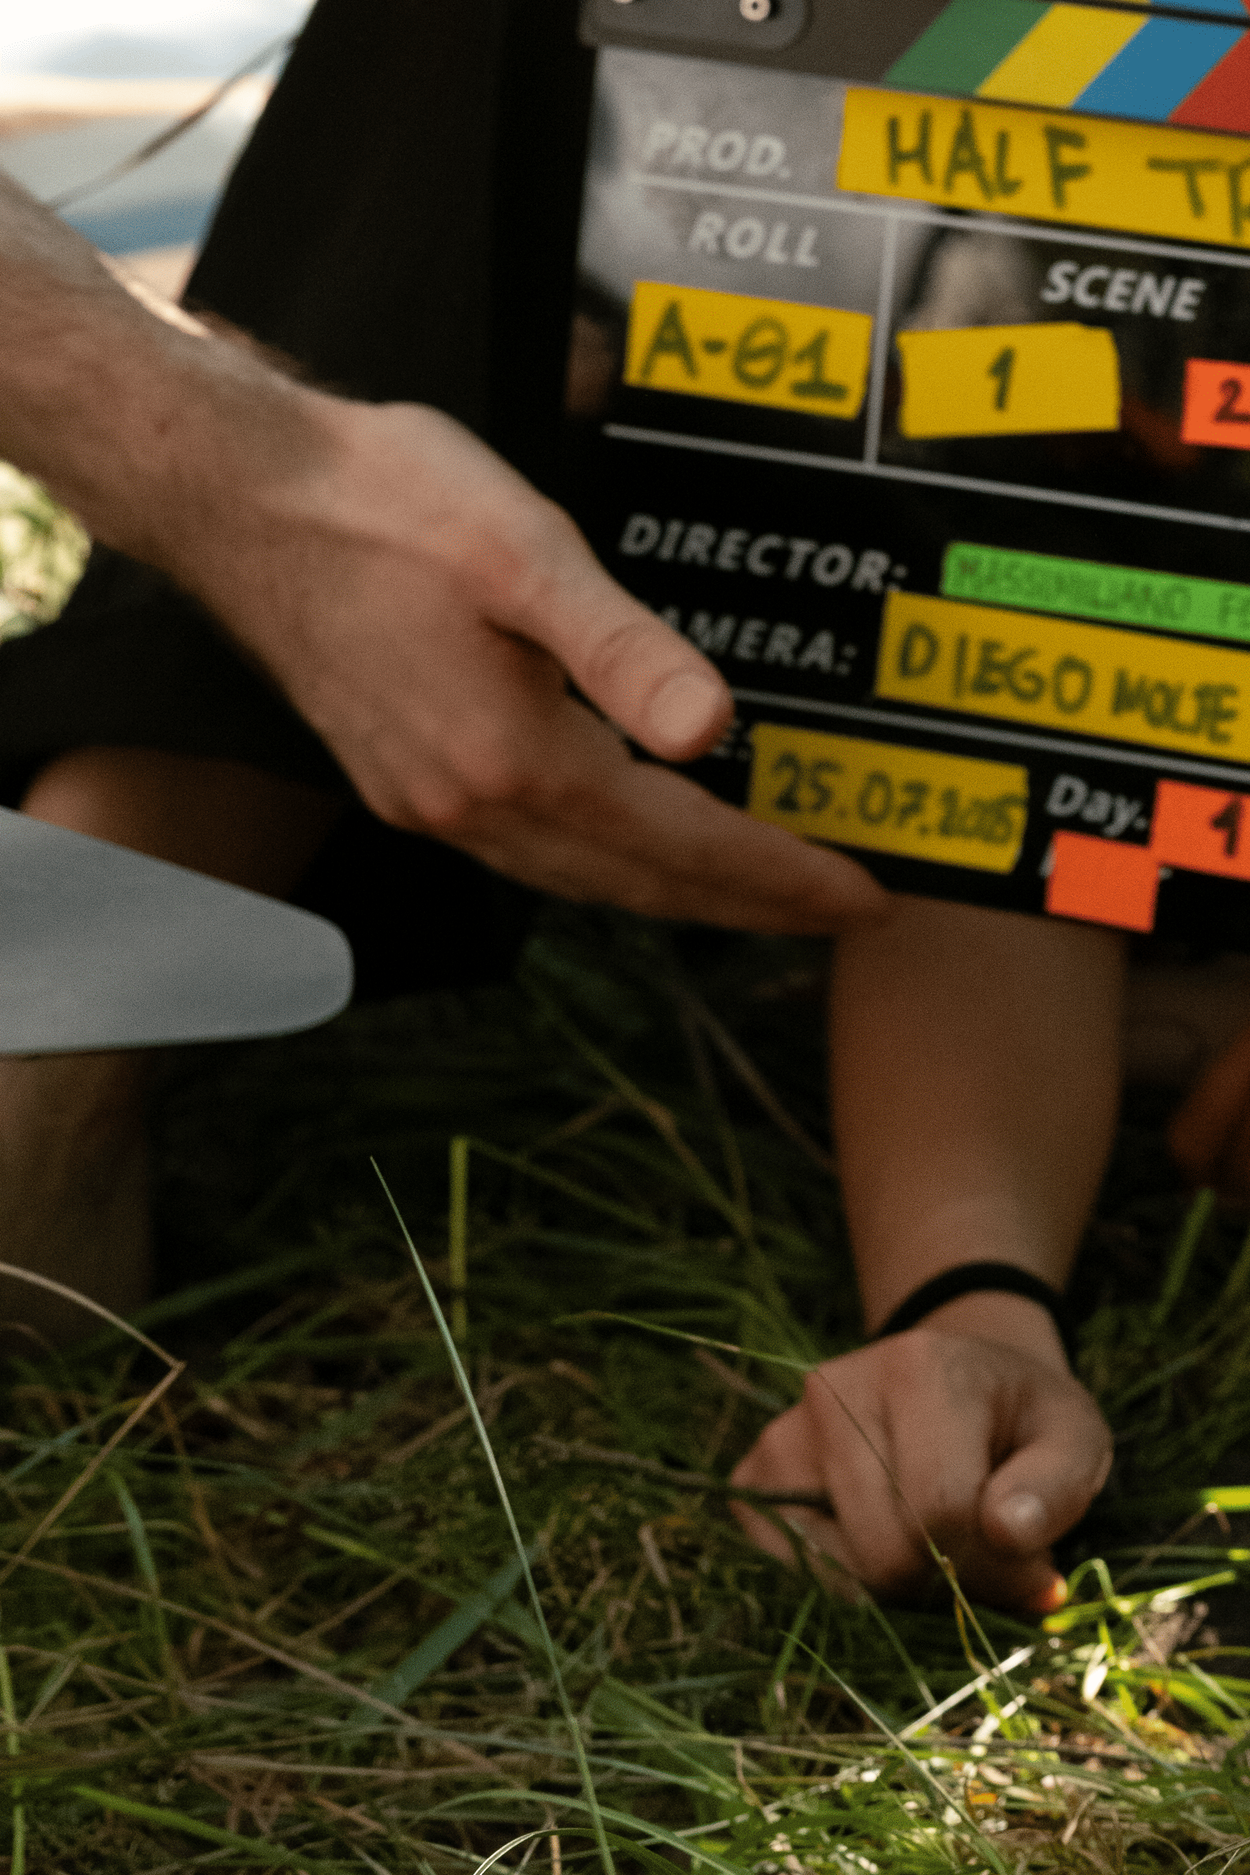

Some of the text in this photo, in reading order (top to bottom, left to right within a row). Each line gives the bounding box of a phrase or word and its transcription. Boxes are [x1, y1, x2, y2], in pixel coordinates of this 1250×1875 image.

[640, 124, 791, 180] PROD.
[886, 106, 1093, 211] HALF
[688, 211, 821, 268] ROLL
[1040, 260, 1206, 323] SCENE
[986, 344, 1017, 413] 1
[619, 512, 908, 593] DIRECTOR:
[897, 621, 1093, 715] DIEGO
